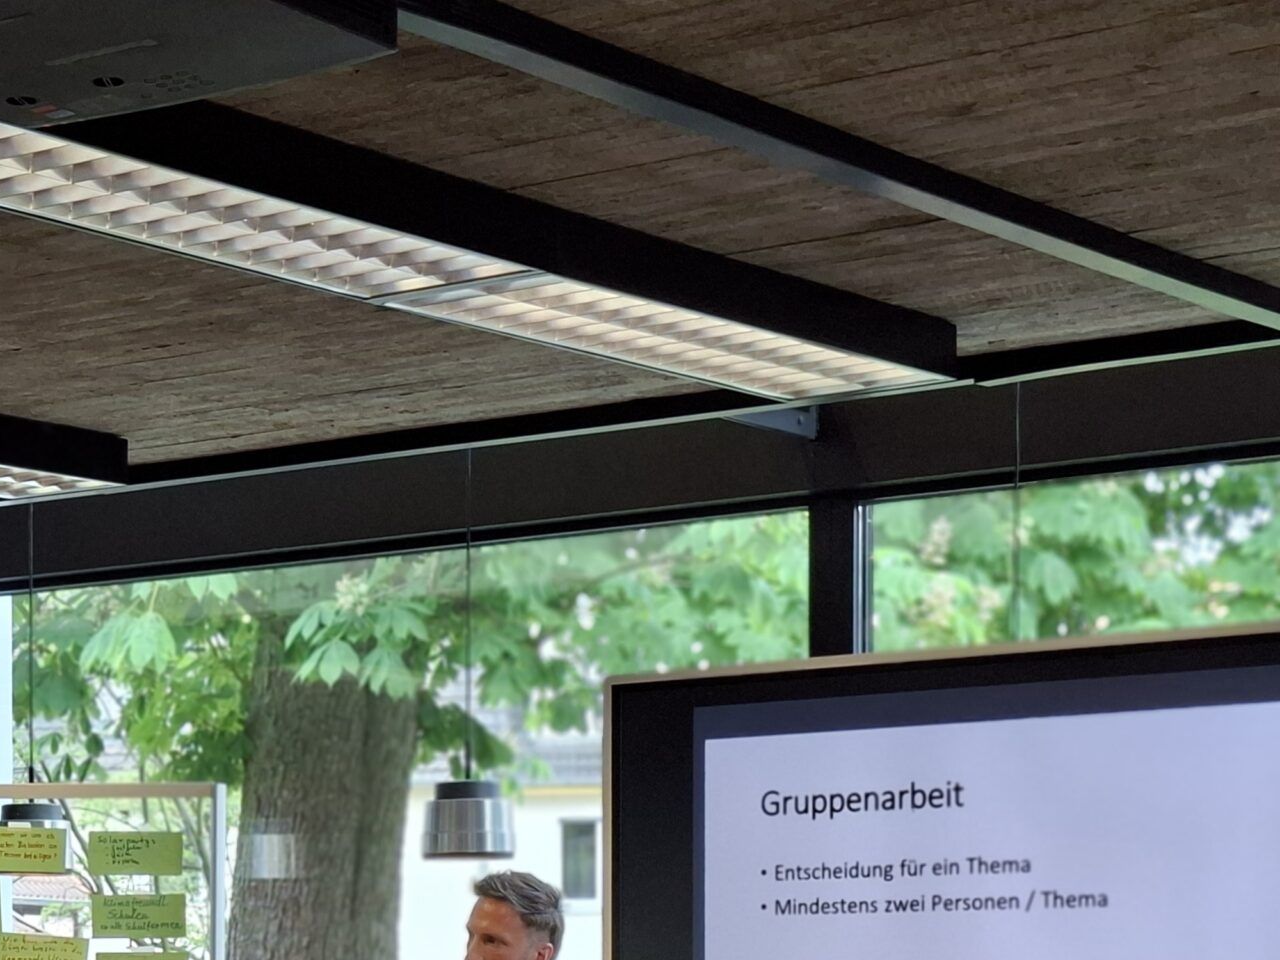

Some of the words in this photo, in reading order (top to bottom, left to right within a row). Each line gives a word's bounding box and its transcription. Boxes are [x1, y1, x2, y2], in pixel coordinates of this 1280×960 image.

[761, 782, 964, 820] Gruppenarbeit
[774, 861, 894, 881] Entscheidung
[900, 858, 926, 877] für
[932, 859, 960, 876] ein
[966, 856, 1032, 875] Thema
[774, 897, 878, 915] Mindestens
[884, 895, 926, 913] zwei
[931, 893, 1020, 912] Personen
[1040, 889, 1109, 909] Thema
